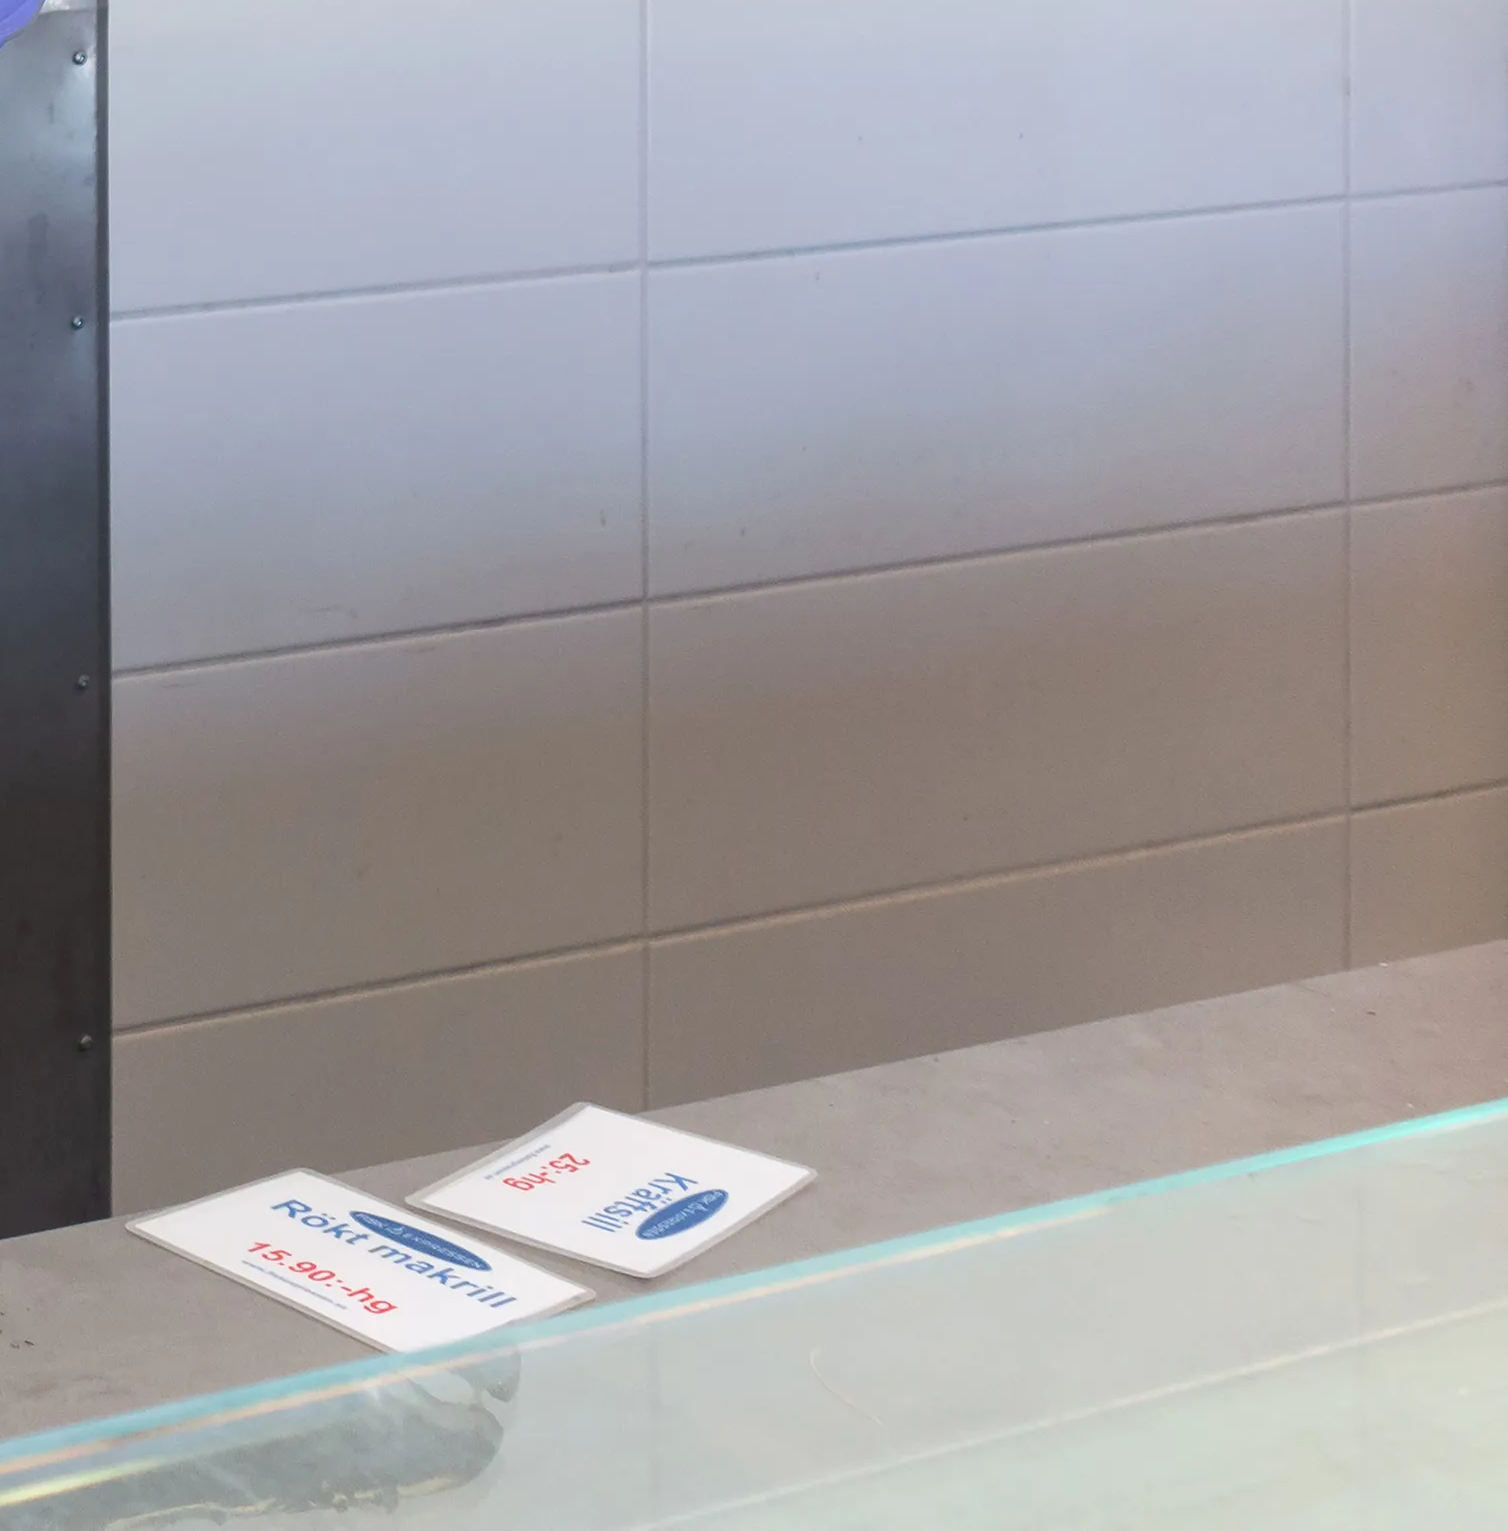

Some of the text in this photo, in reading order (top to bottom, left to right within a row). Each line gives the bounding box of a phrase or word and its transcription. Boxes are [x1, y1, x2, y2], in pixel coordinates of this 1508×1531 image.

[581, 1172, 699, 1233] Kräftsill
[271, 1199, 370, 1246] Rökt
[368, 1244, 517, 1309] makrill
